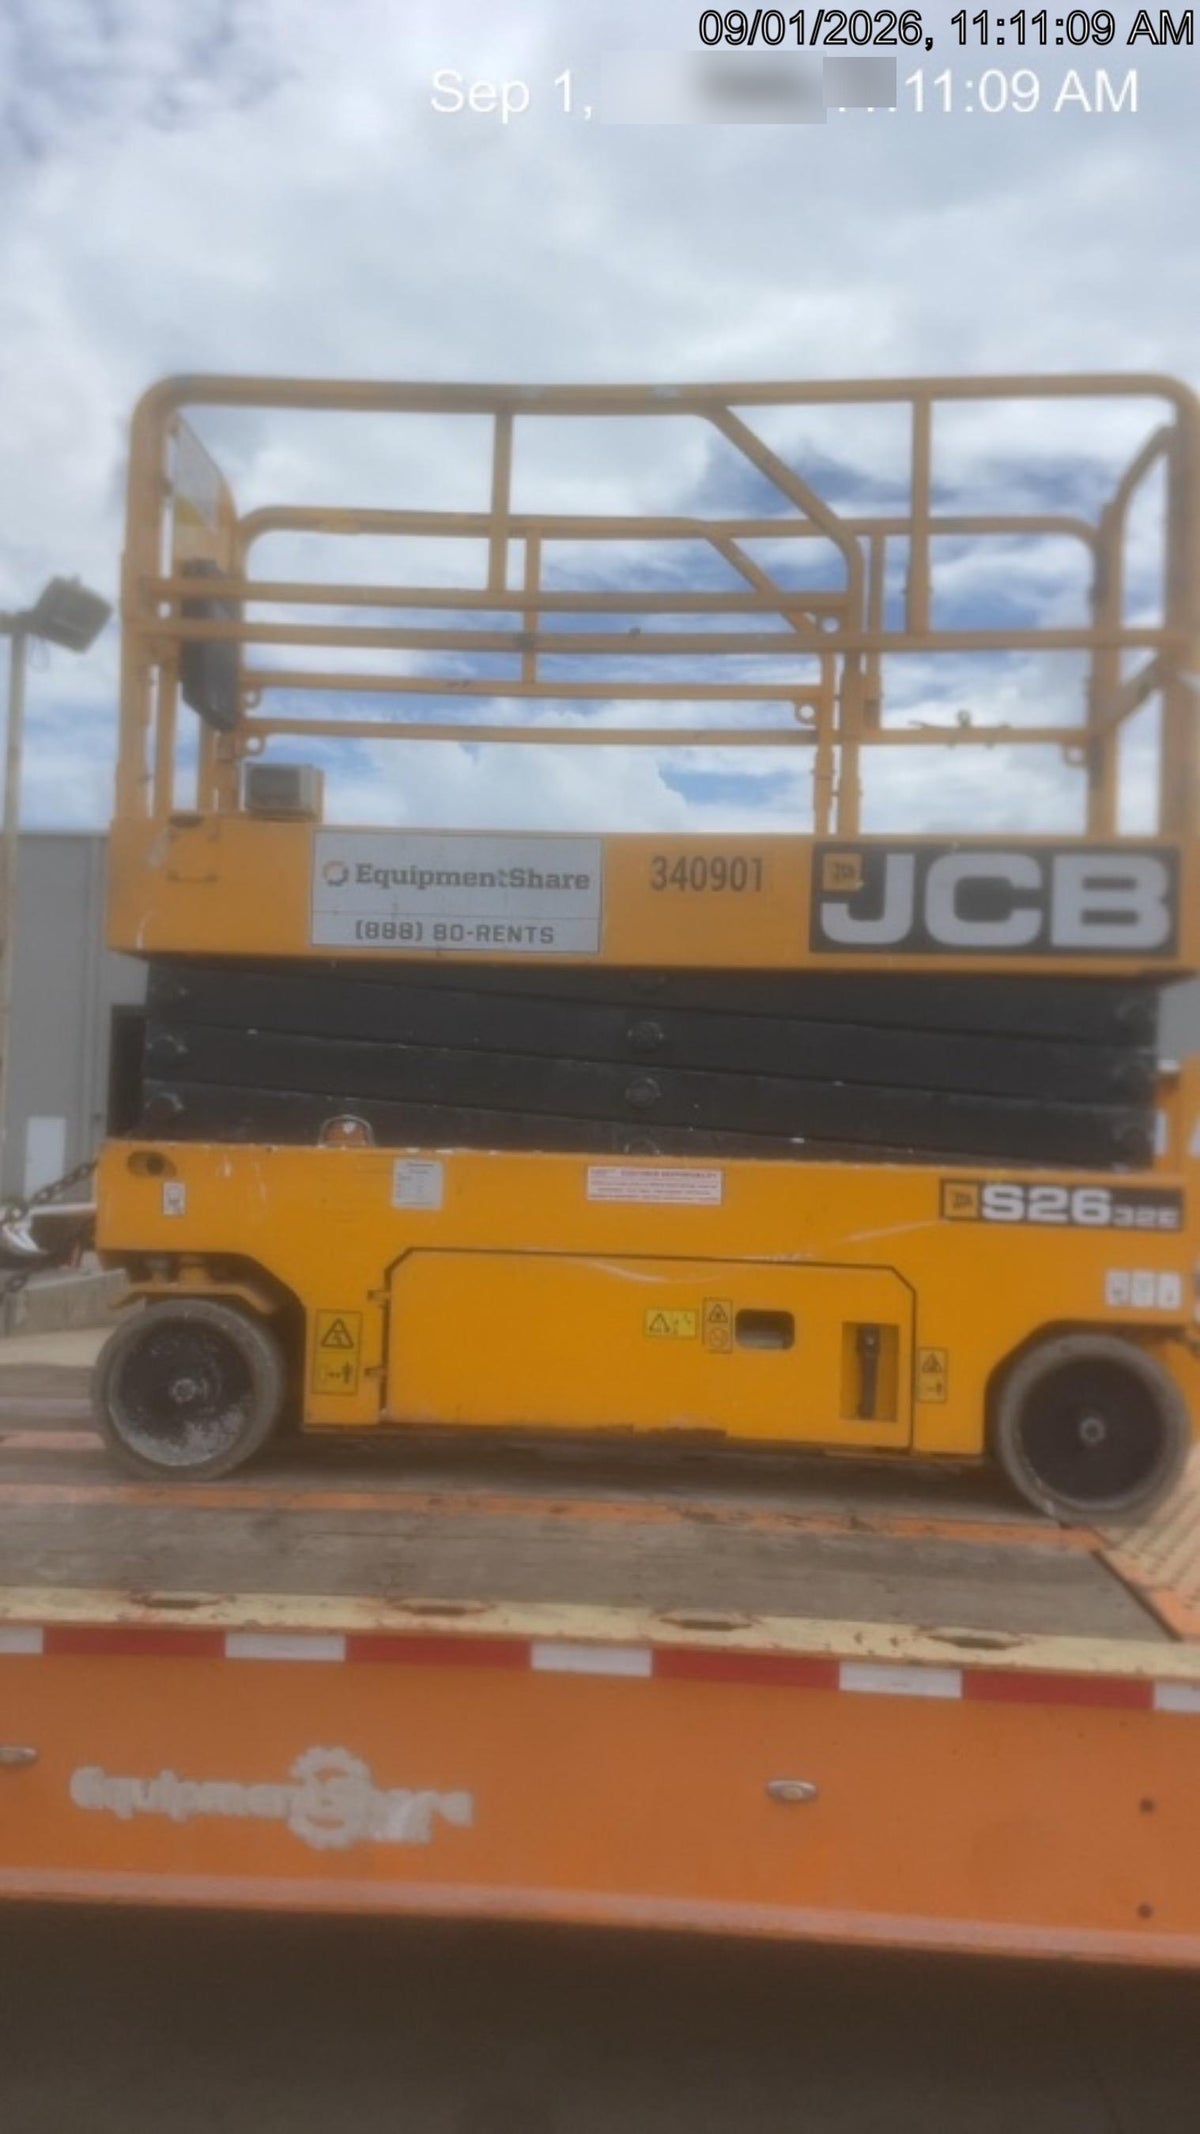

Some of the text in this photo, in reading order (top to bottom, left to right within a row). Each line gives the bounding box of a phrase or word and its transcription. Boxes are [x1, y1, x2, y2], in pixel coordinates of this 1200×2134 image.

[354, 863, 591, 890] EquipmentShare
[650, 855, 764, 893] 340901
[820, 852, 1171, 947] JCB
[355, 919, 424, 942] (888)
[981, 1184, 1112, 1225] S26
